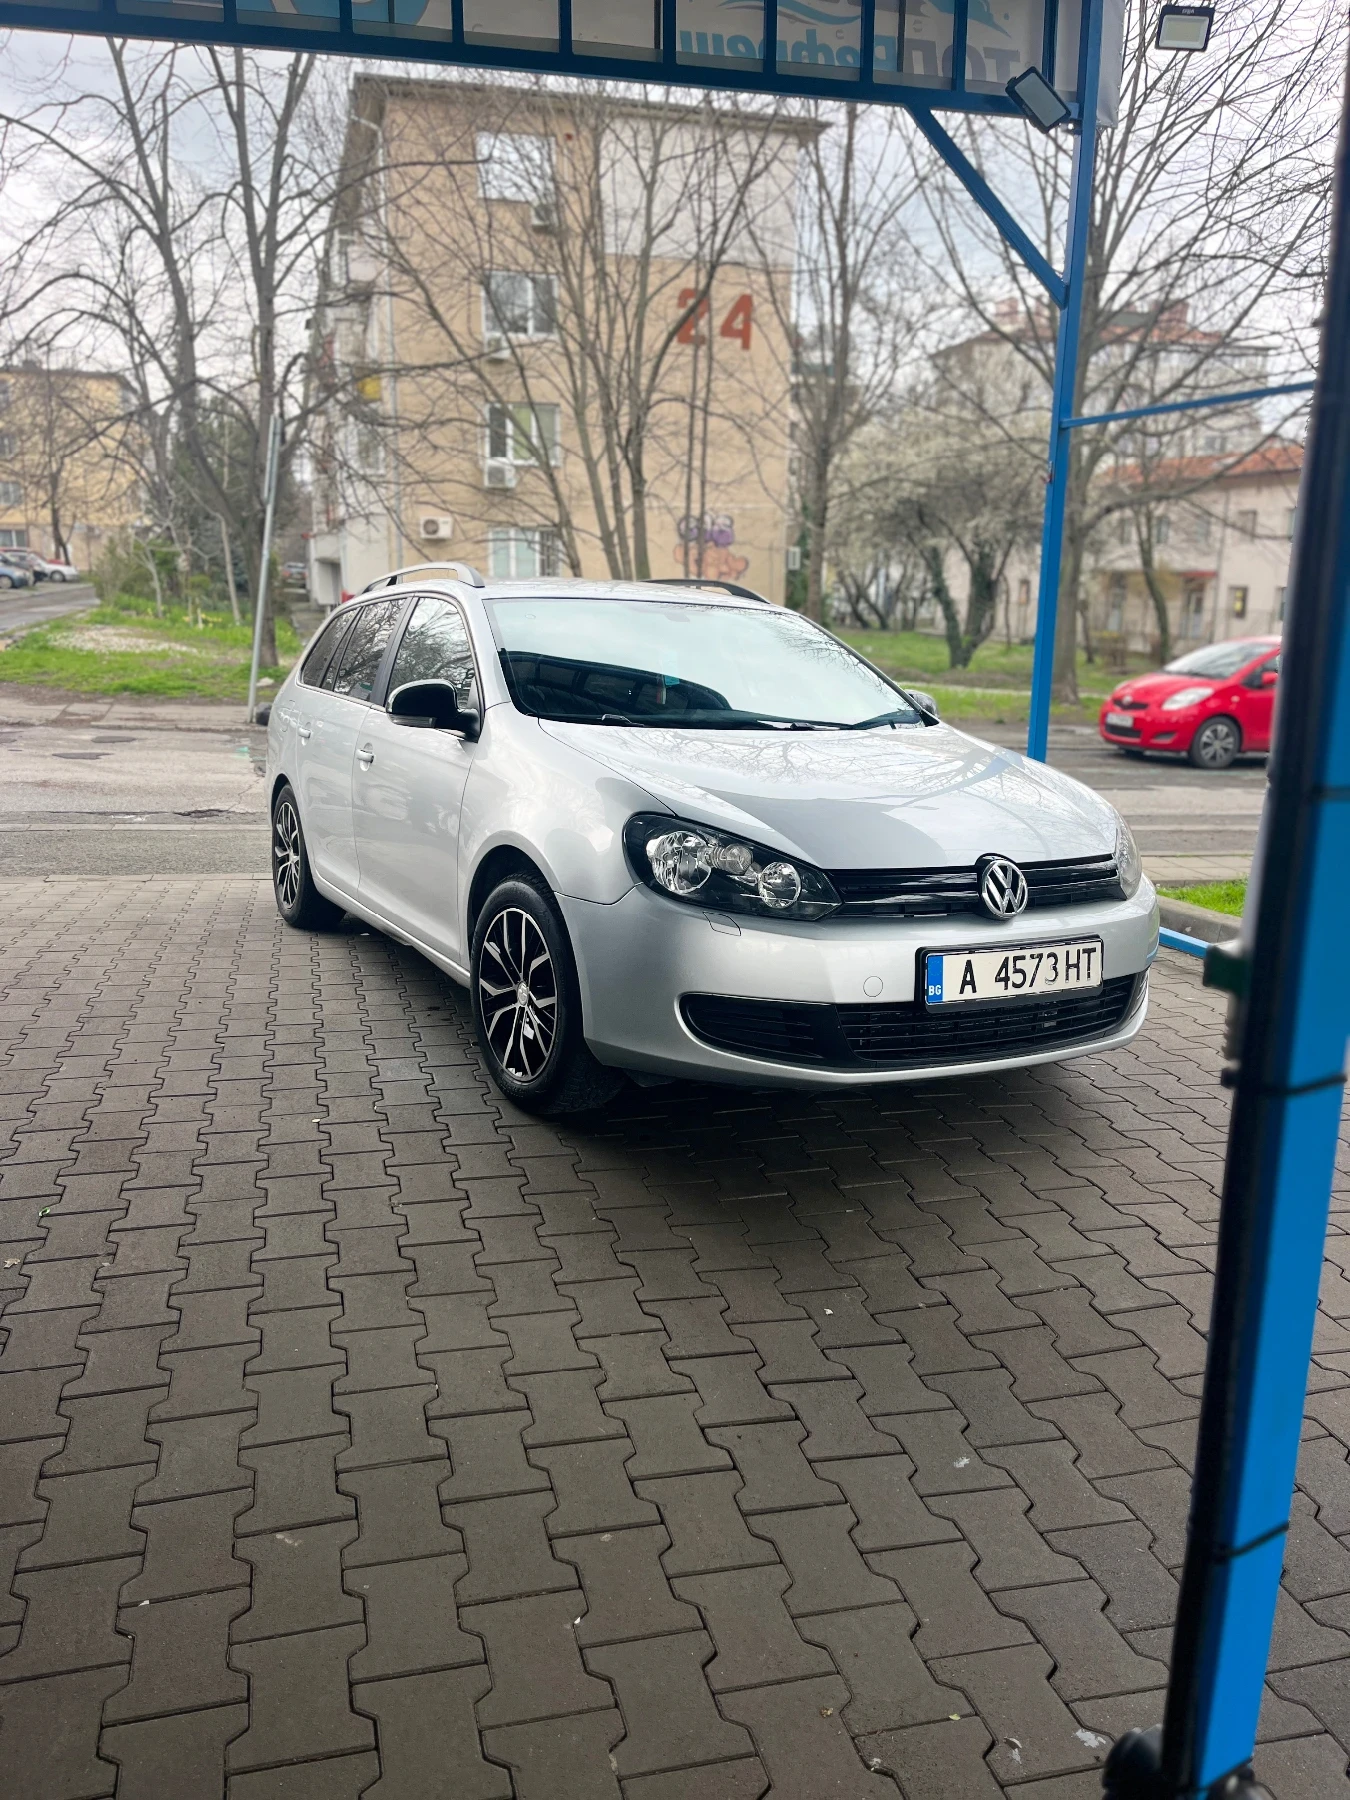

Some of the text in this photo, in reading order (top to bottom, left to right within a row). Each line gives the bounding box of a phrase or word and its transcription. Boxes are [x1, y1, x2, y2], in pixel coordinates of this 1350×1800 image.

[677, 287, 753, 350] 24
[928, 984, 942, 996] BG
[959, 947, 1097, 995] A 4573 HT
